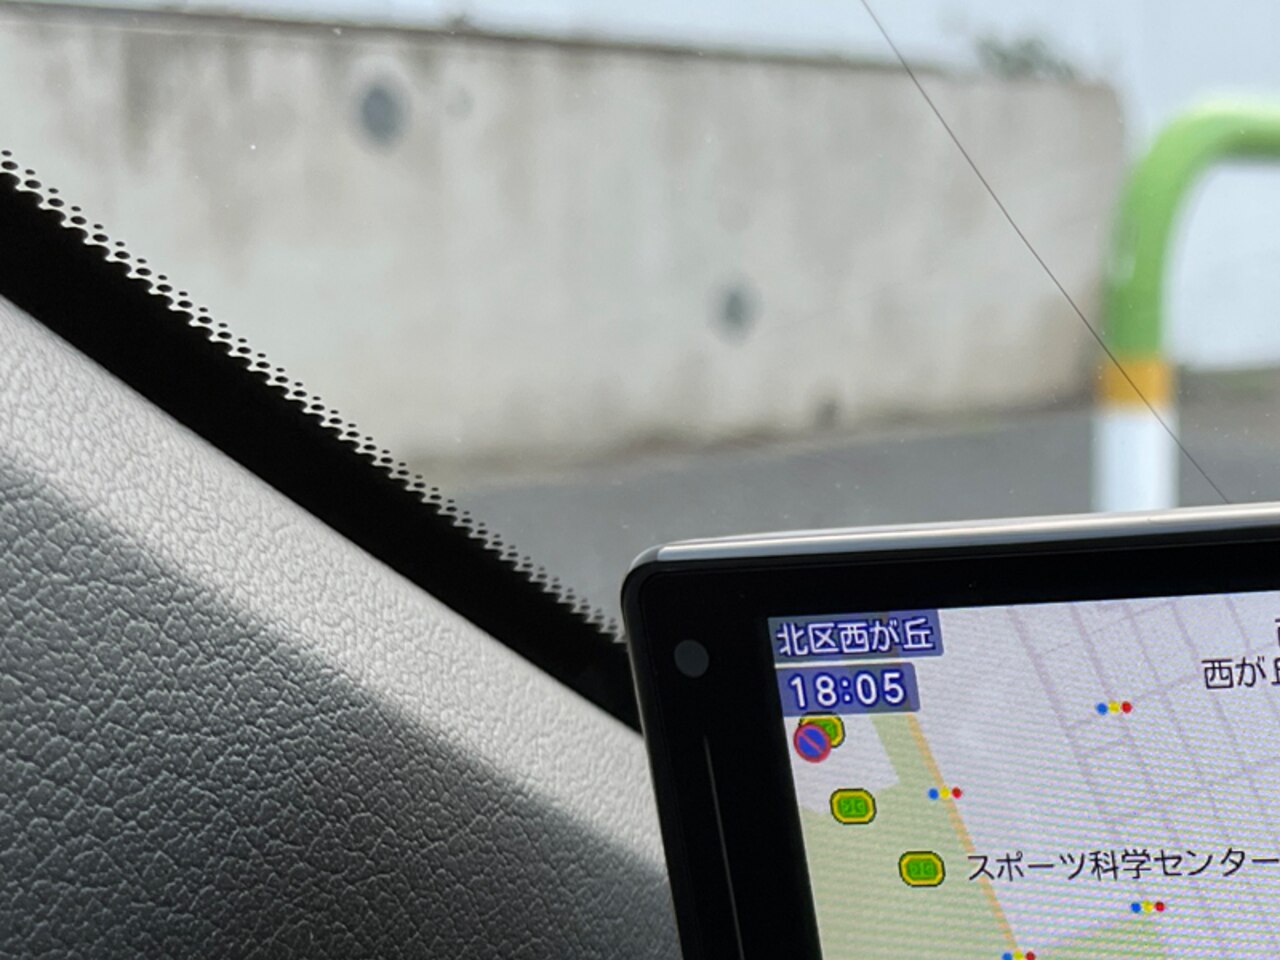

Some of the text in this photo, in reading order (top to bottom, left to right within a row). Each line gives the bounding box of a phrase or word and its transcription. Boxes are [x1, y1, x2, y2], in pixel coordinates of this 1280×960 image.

[775, 617, 935, 656] 北区西が丘
[789, 671, 905, 708] 18:05
[967, 847, 1280, 881] スポーツ科学センター
